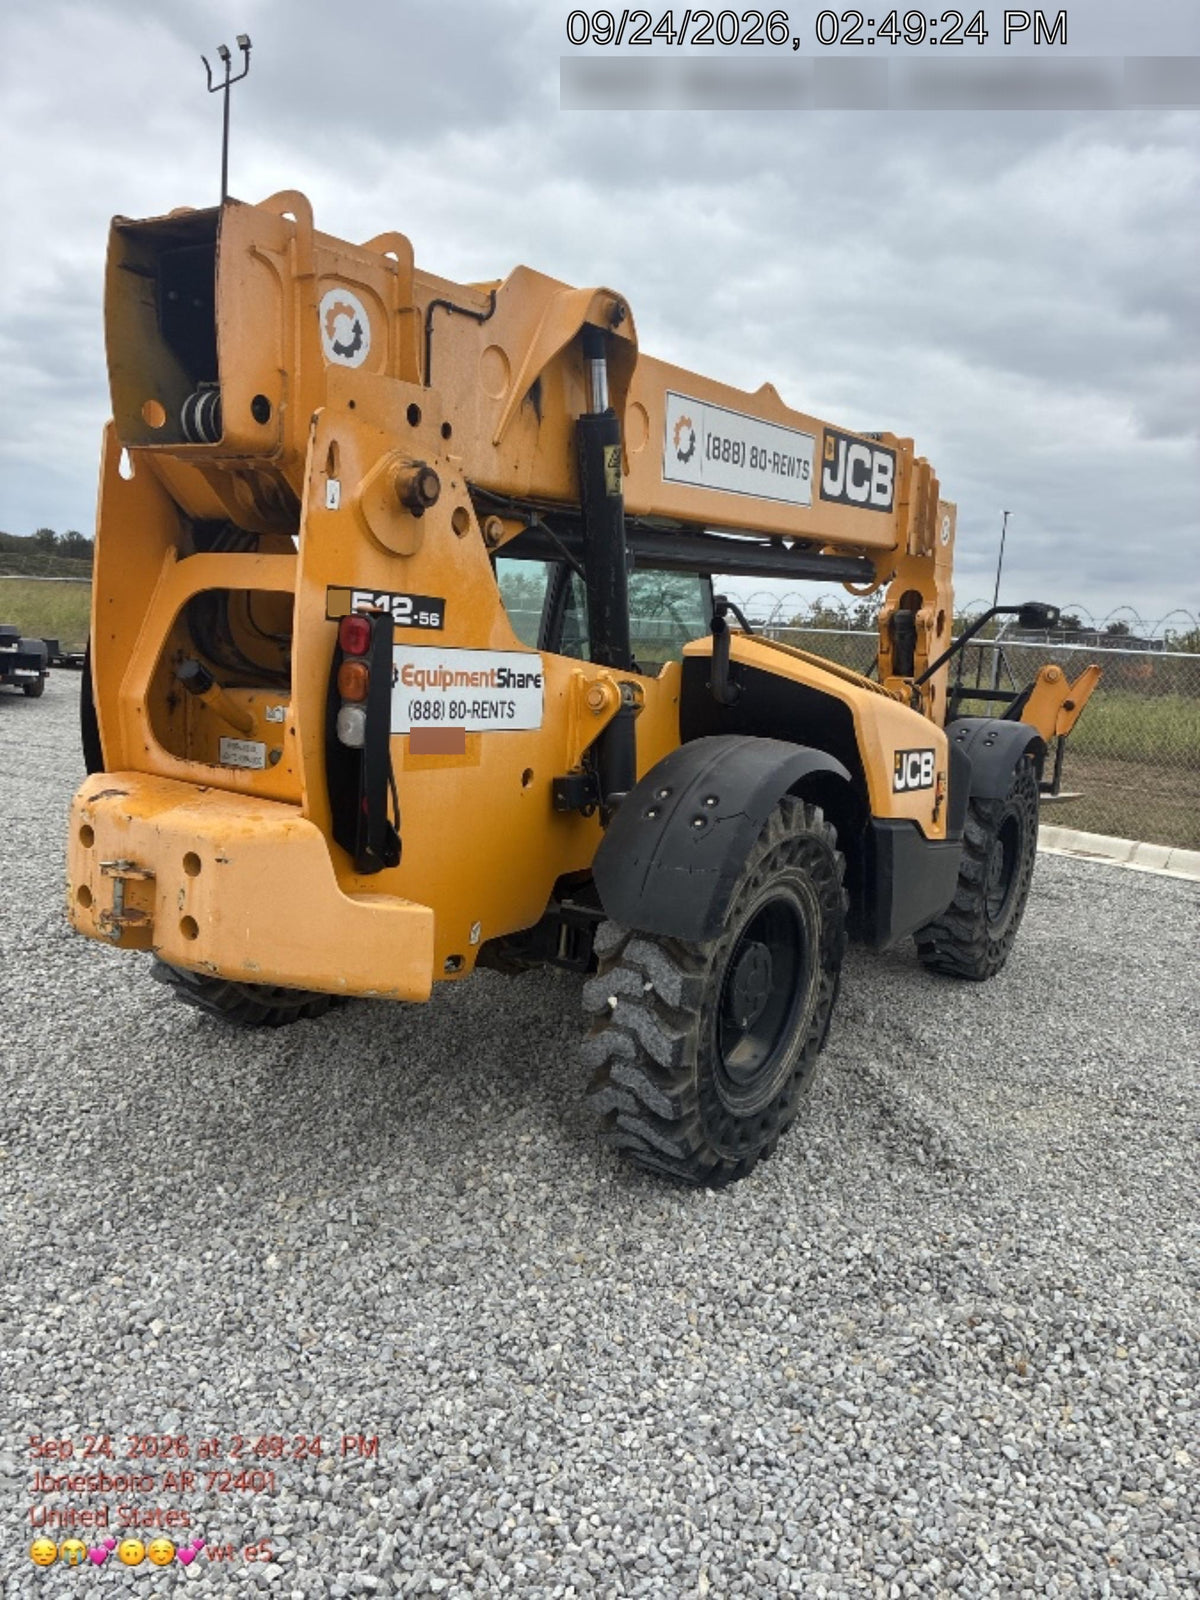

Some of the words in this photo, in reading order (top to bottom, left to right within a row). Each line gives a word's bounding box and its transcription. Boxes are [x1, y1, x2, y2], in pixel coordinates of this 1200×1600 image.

[706, 432, 746, 468] (888)
[750, 446, 810, 481] 80-RENTS
[823, 440, 894, 506] JCB
[401, 664, 542, 692] EquipmentShare
[408, 699, 445, 721] (888)
[449, 701, 516, 719] 80-RENTS
[894, 751, 934, 790] JCB
